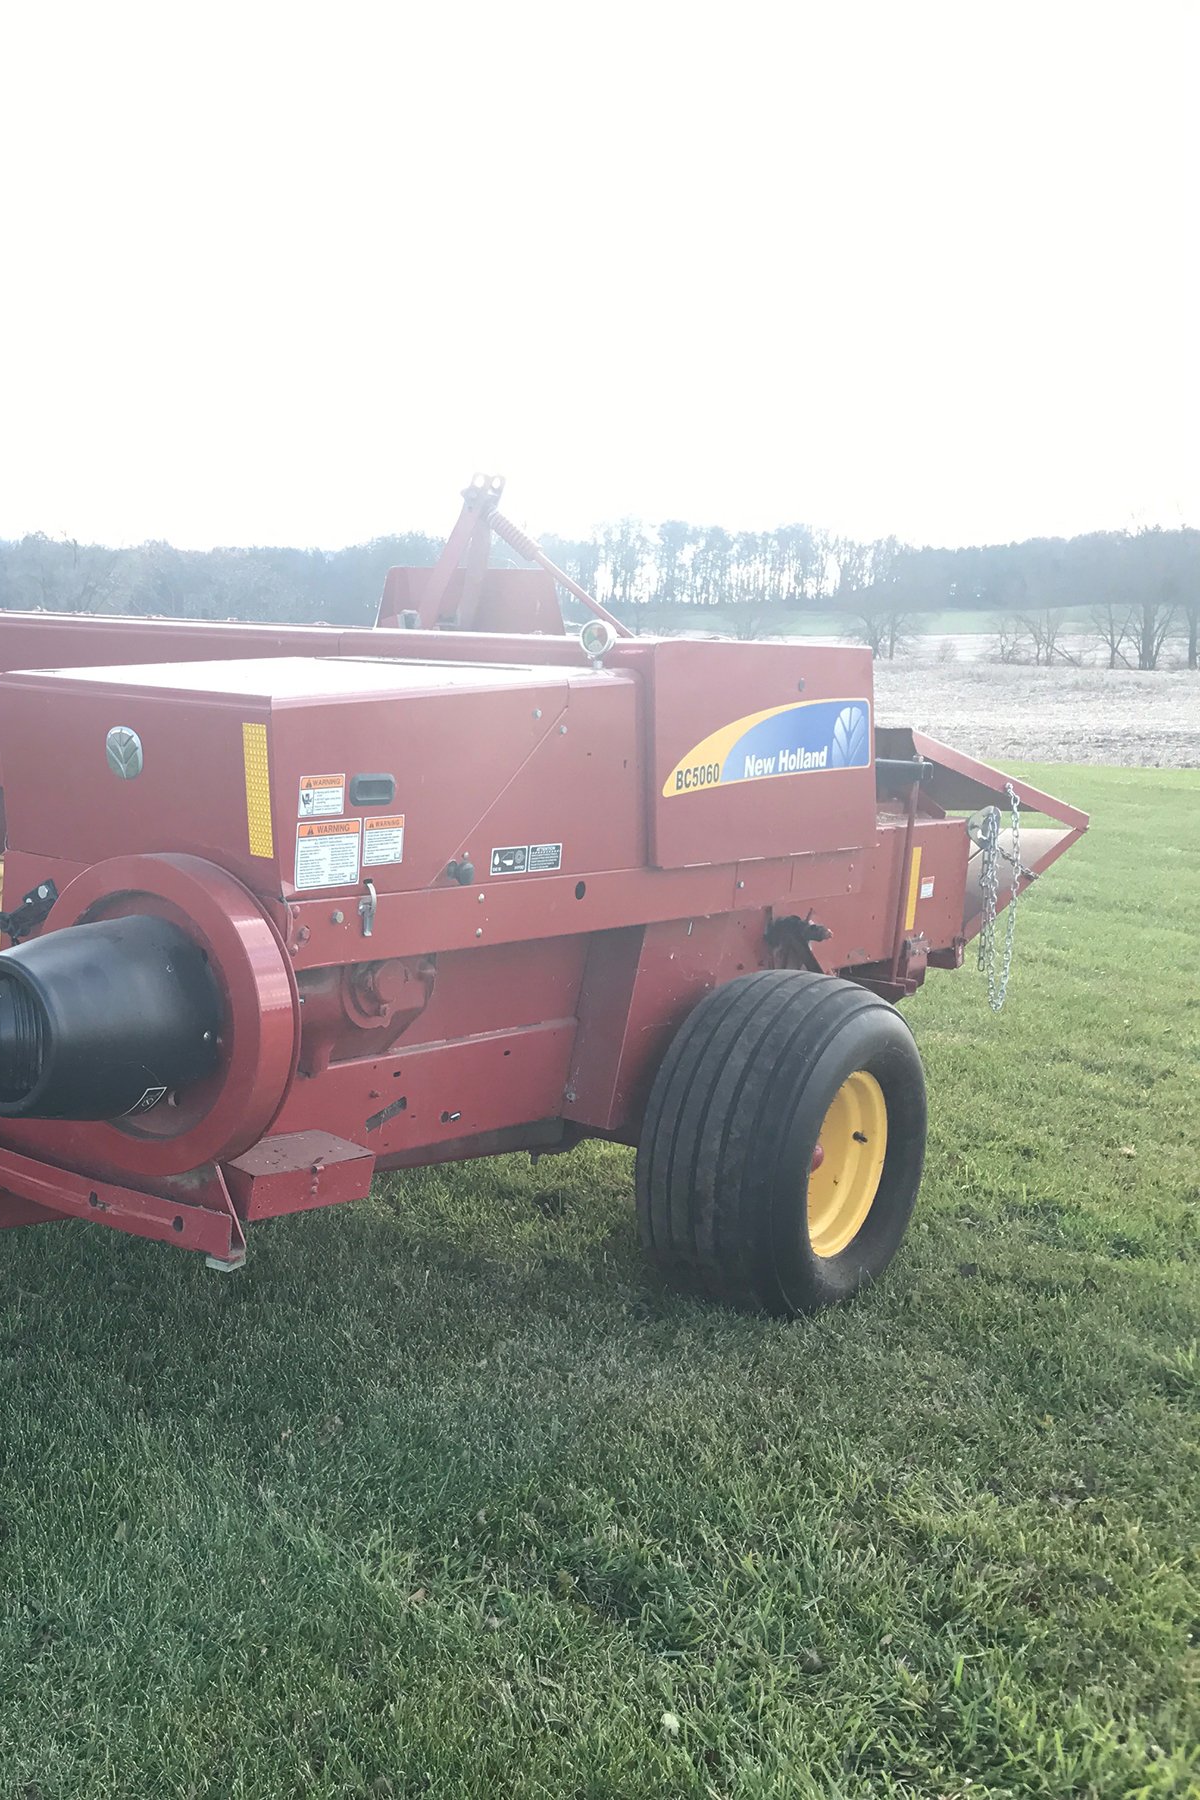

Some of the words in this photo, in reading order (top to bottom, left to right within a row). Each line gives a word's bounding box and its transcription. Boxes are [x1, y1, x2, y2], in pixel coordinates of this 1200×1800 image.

[744, 755, 775, 778] New
[778, 746, 828, 772] Holland
[312, 778, 340, 786] WARNING
[675, 763, 720, 791] BC5060
[317, 823, 350, 834] WARNING
[375, 819, 400, 827] WARNING
